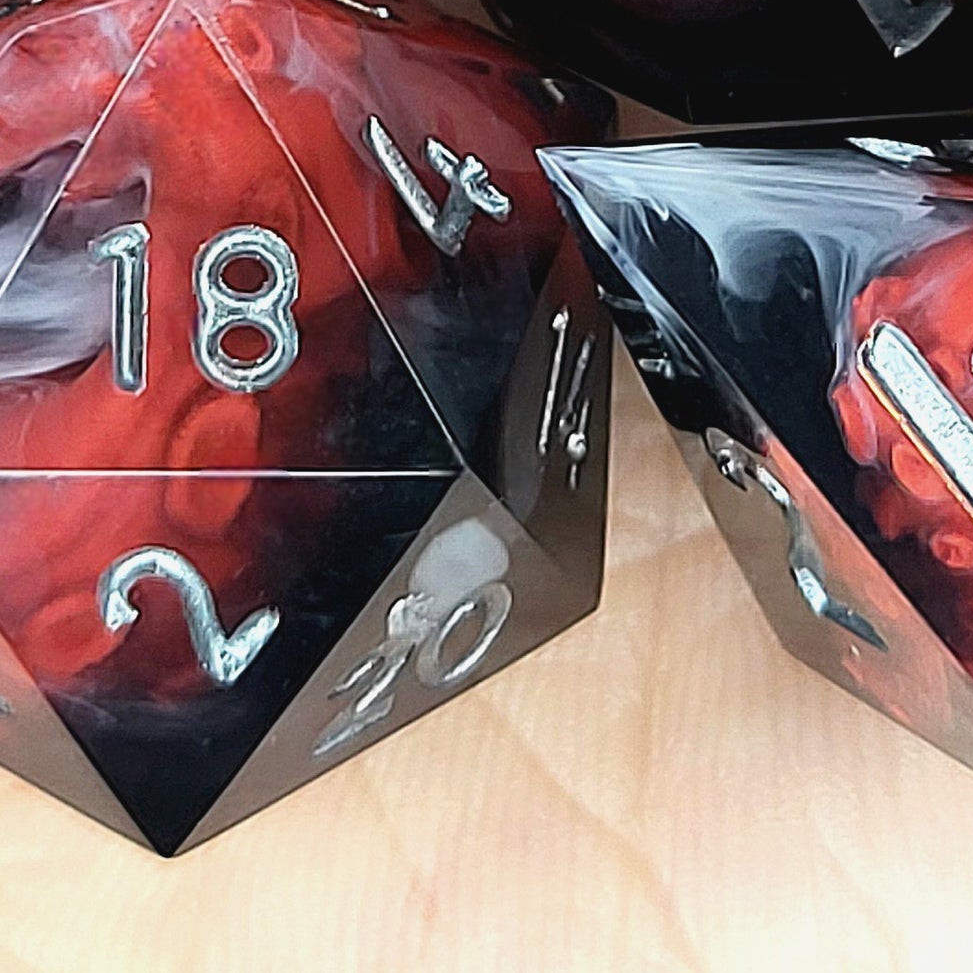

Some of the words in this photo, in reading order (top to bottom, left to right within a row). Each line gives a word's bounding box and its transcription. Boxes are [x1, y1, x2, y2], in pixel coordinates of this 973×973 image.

[362, 113, 513, 258] 4
[87, 222, 300, 397] 18
[96, 543, 281, 689] 2
